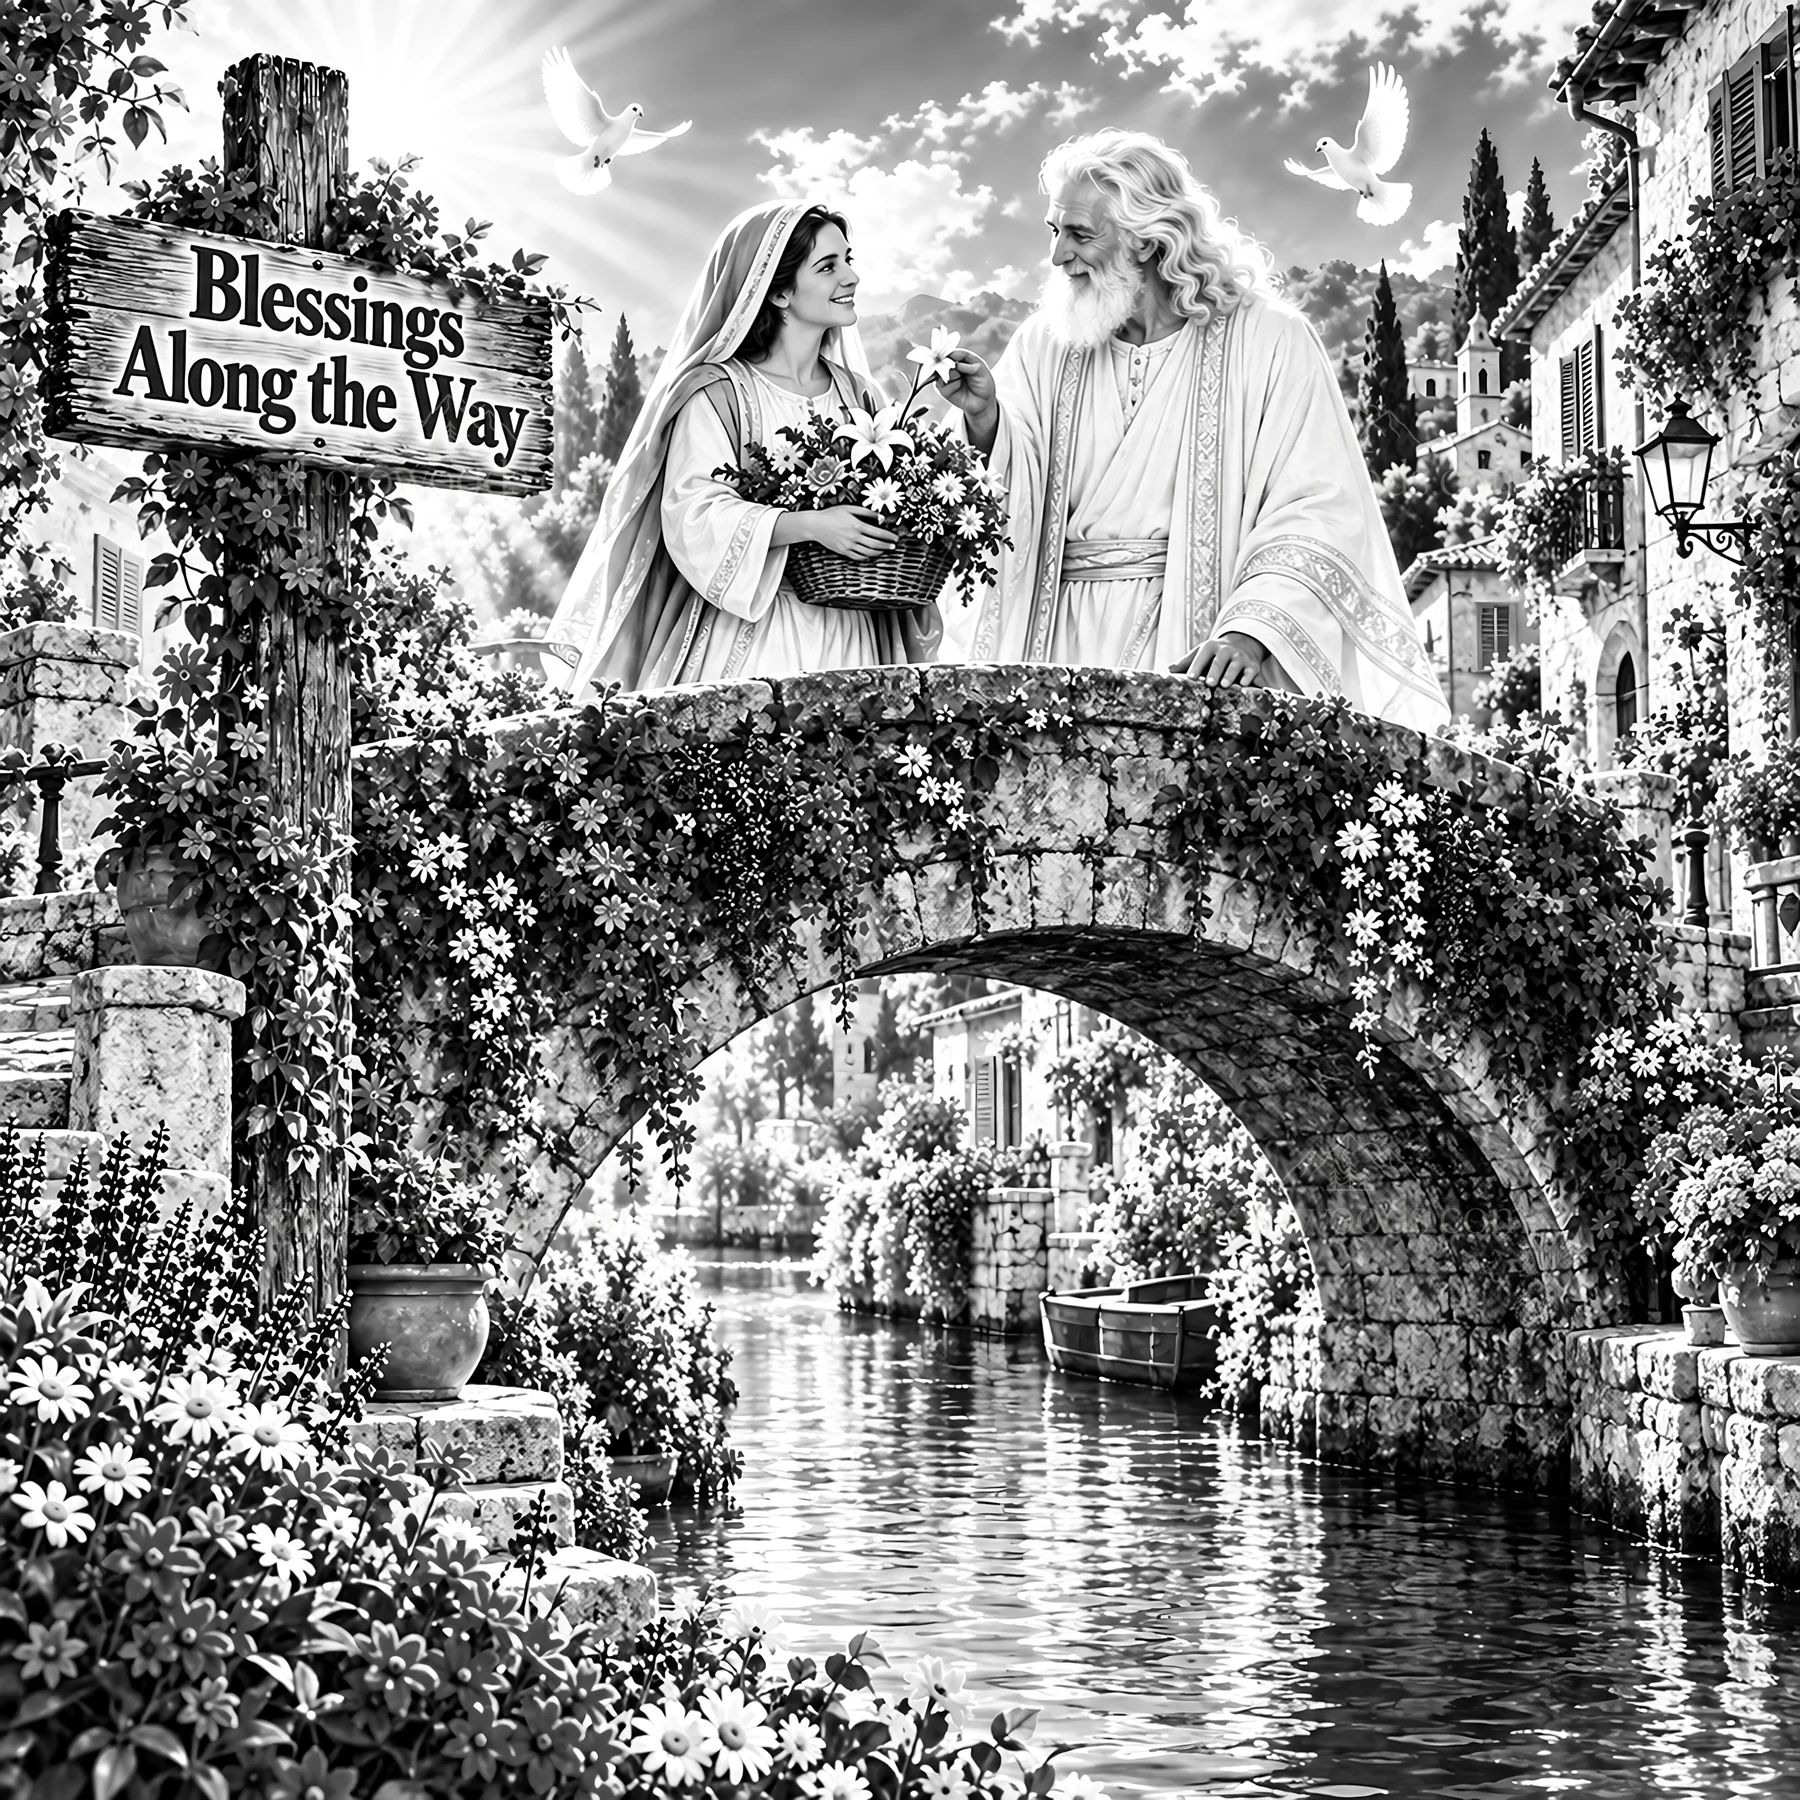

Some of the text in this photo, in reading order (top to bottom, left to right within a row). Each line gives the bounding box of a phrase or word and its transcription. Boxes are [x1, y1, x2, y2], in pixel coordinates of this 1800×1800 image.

[189, 244, 464, 370] Blessings
[112, 325, 530, 468] Along the Way
